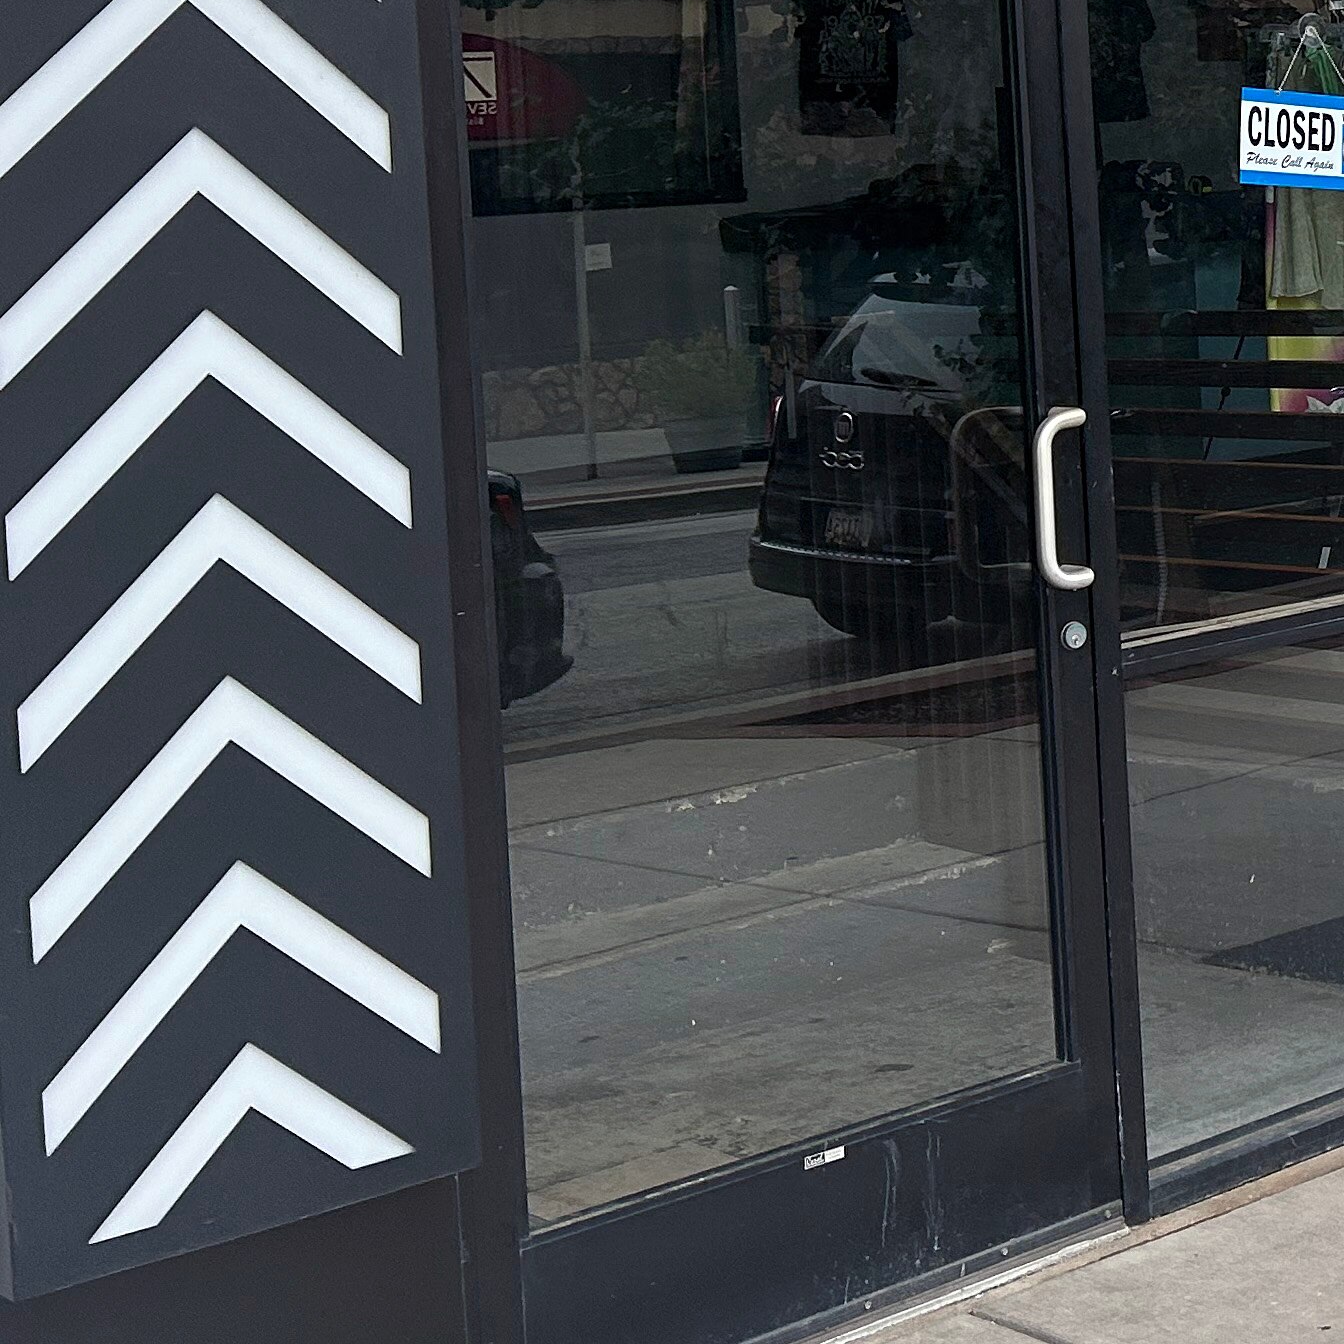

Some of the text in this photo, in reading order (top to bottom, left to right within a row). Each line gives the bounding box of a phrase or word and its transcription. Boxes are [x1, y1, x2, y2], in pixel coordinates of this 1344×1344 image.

[1248, 106, 1336, 152] CLOSED
[1246, 152, 1334, 172] Please Call Again
